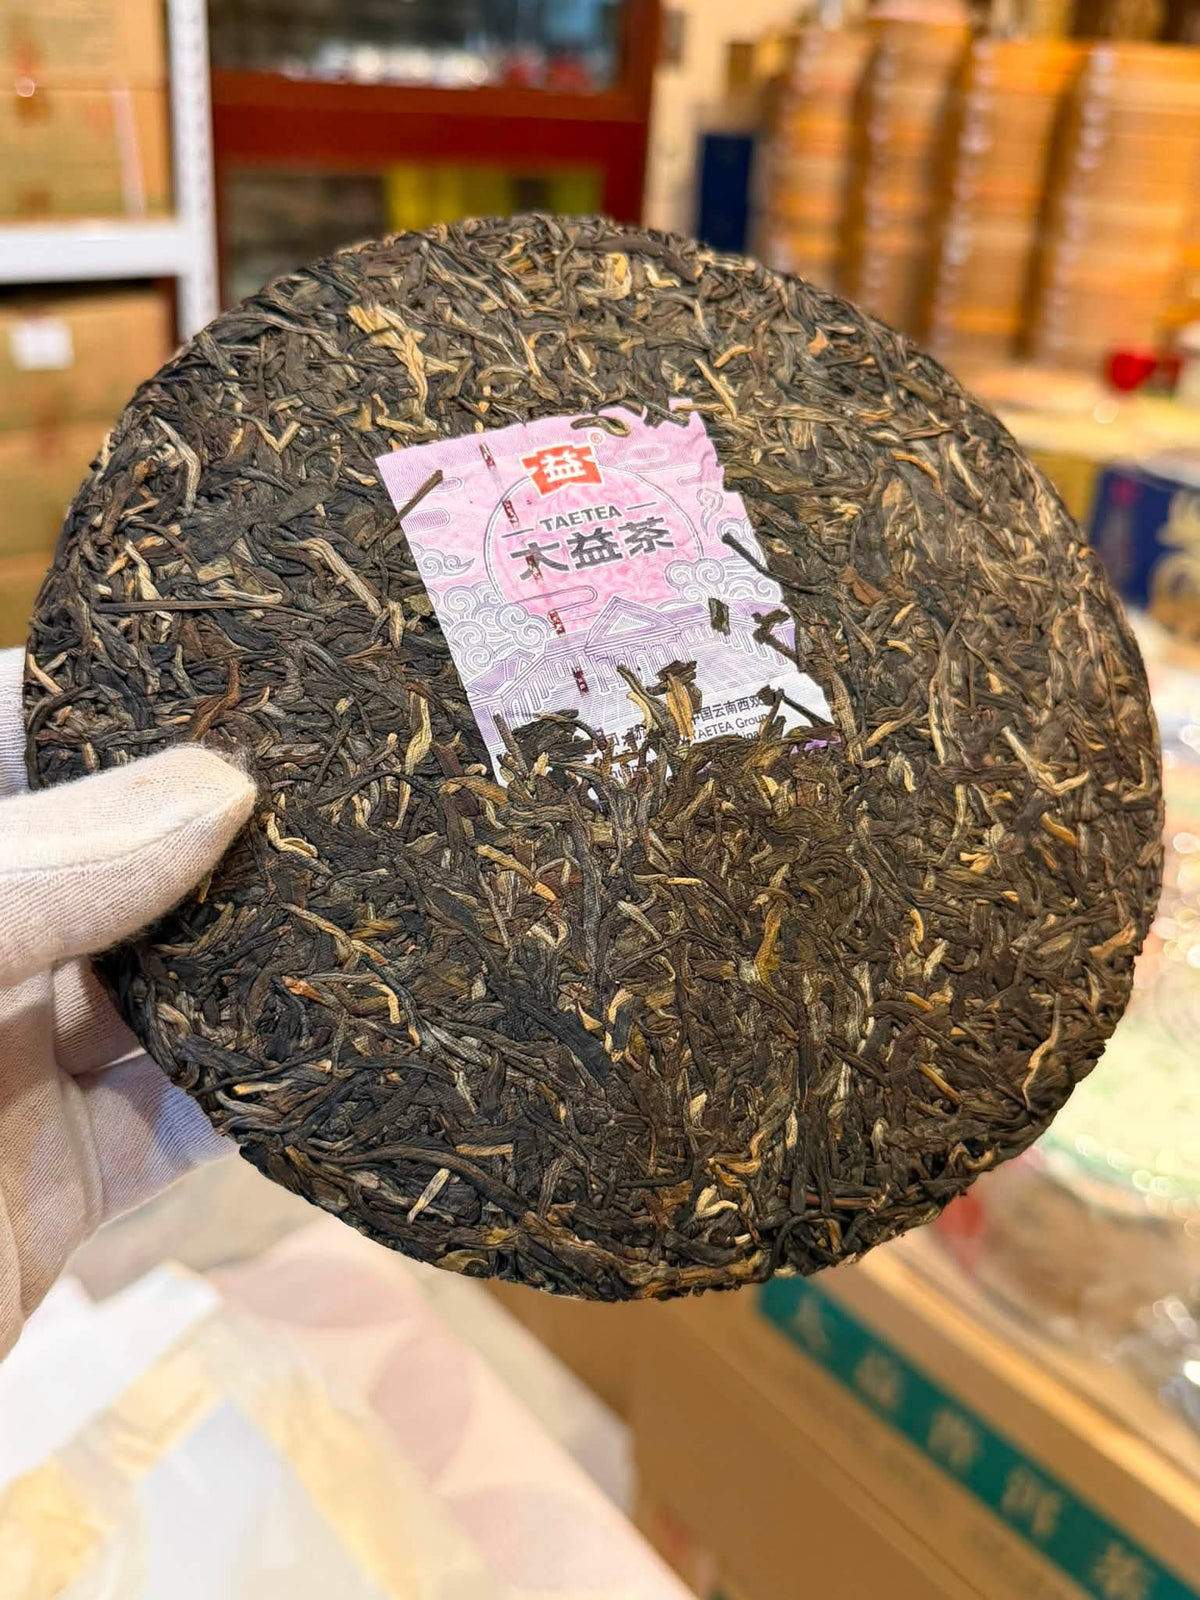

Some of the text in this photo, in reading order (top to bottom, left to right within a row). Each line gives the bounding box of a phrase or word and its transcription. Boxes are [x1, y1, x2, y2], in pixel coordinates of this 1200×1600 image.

[540, 505, 623, 532] TAETEA
[510, 516, 675, 581] 大益茶
